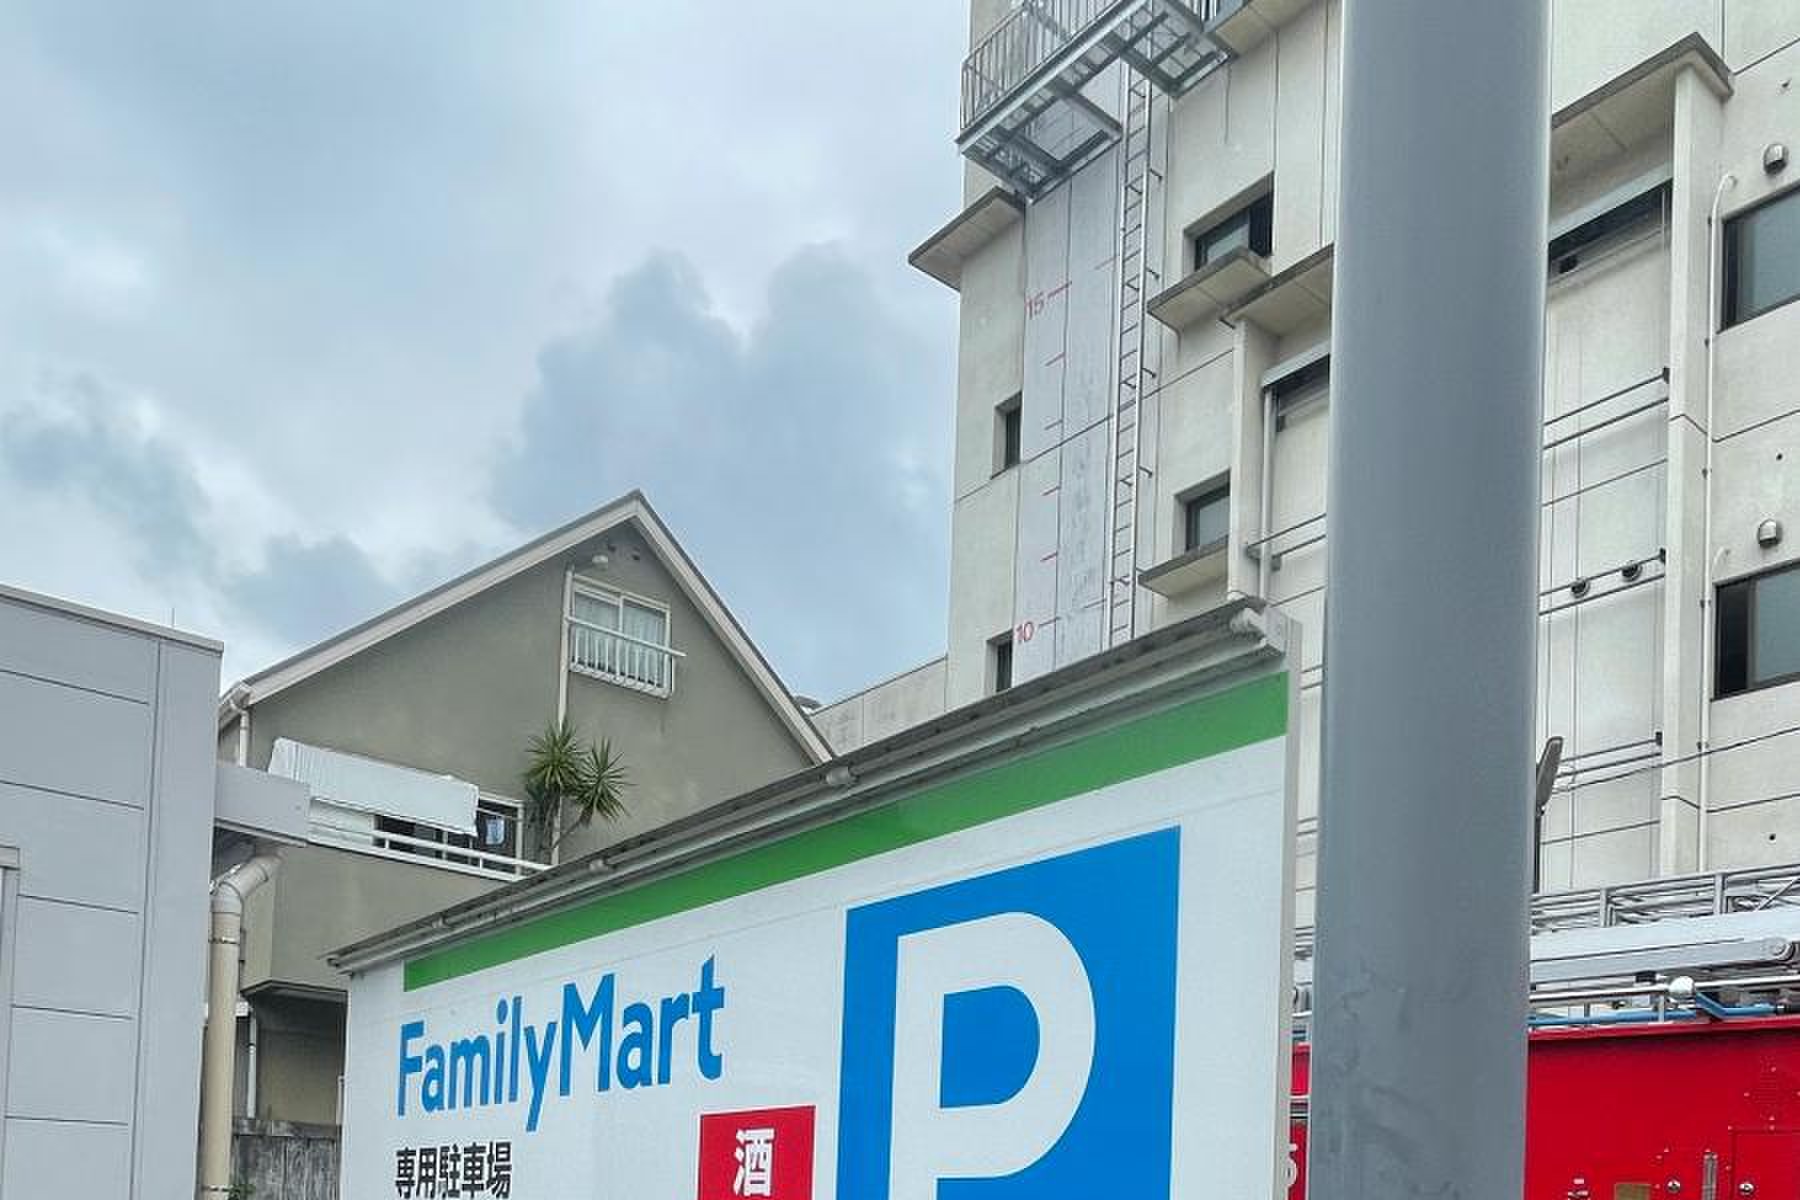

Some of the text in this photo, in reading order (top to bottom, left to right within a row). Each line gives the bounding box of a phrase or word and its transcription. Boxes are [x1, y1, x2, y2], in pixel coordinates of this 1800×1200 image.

[1025, 291, 1044, 319] 15
[1016, 621, 1035, 645] 10
[396, 955, 725, 1133] FamilyMart
[395, 1141, 513, 1200] 専用駐車場
[733, 1127, 775, 1198] 酒
